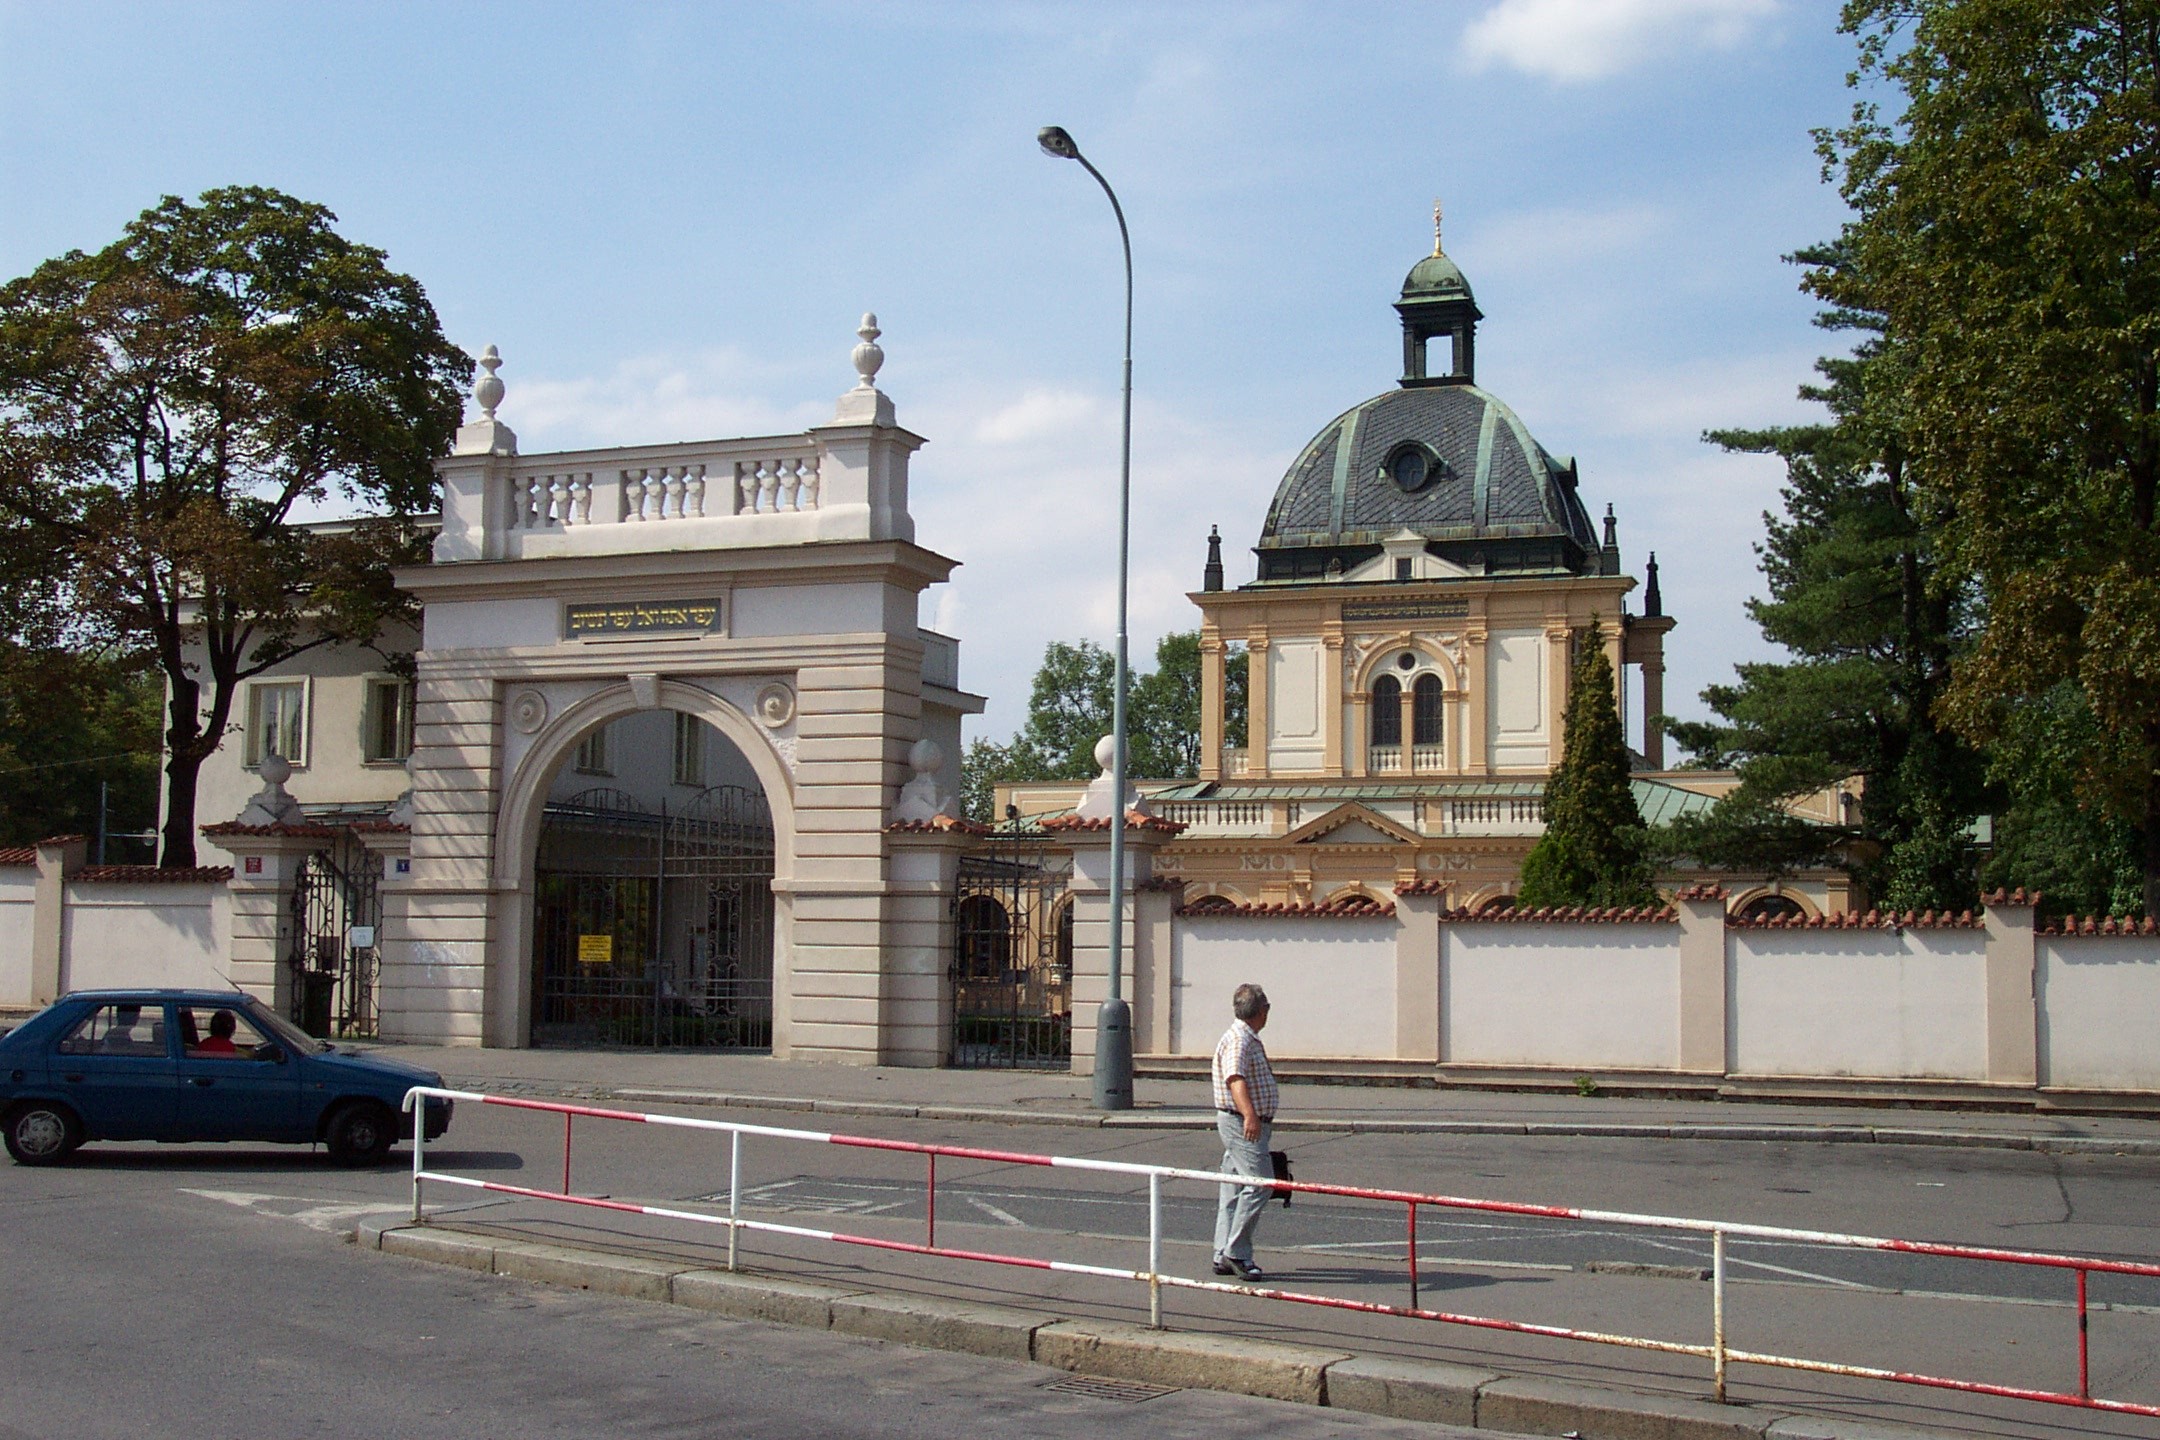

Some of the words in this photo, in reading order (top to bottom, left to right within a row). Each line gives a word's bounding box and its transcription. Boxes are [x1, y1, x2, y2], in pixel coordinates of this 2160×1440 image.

[572, 613, 607, 628] תשוב
[609, 611, 634, 628] עפר
[636, 605, 659, 625] ואל
[662, 609, 688, 625] אתה
[690, 608, 715, 625] עפר
